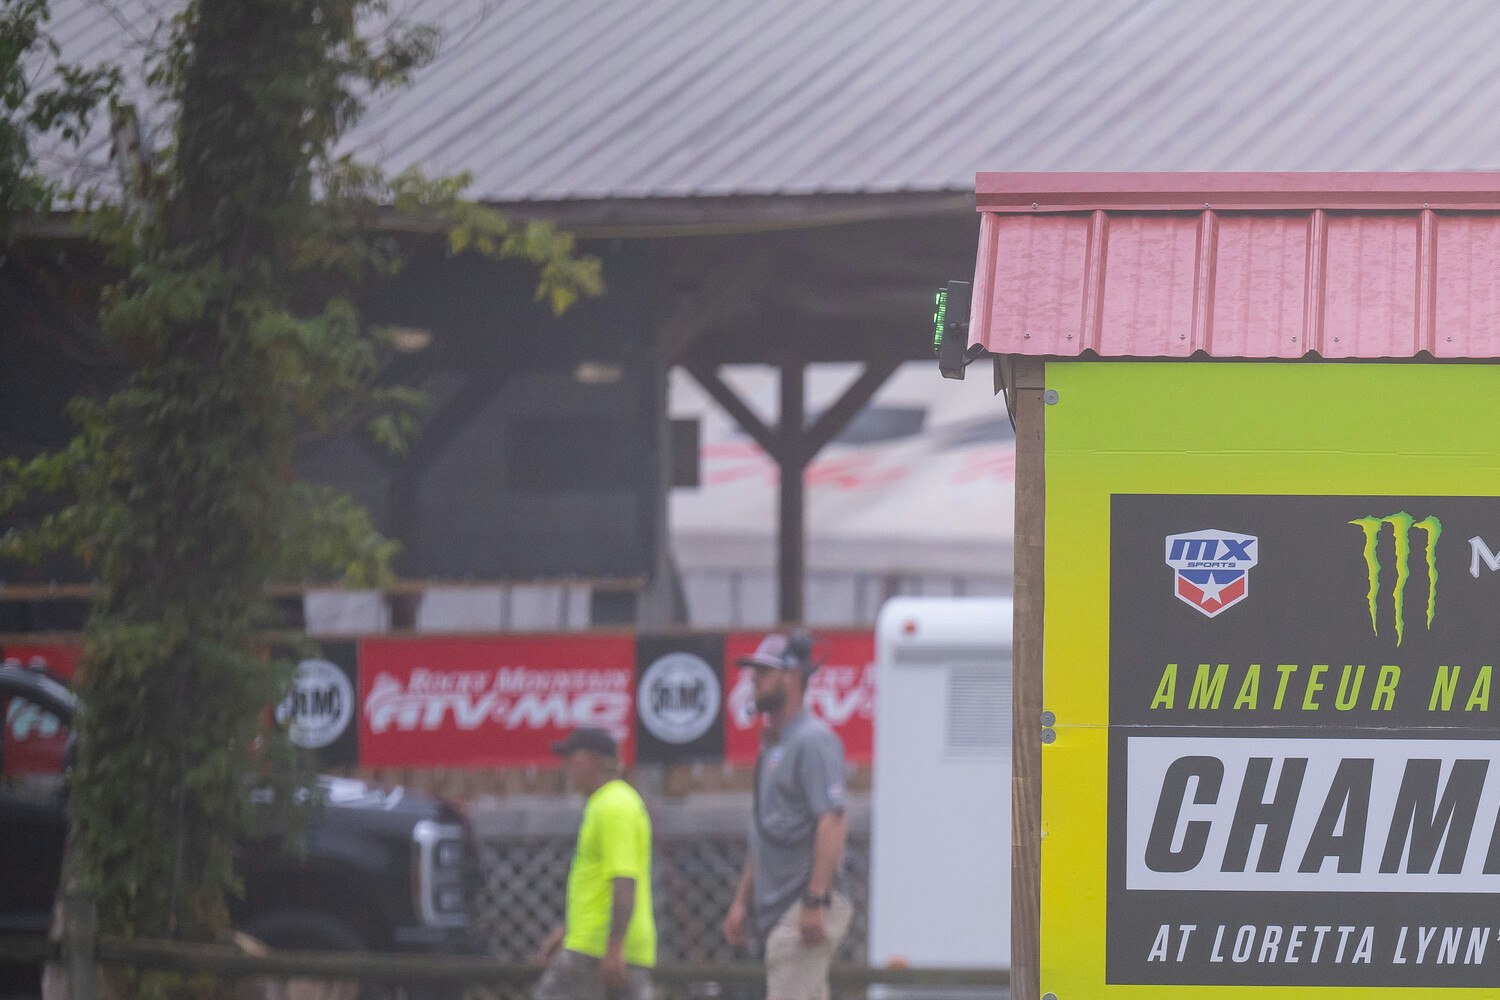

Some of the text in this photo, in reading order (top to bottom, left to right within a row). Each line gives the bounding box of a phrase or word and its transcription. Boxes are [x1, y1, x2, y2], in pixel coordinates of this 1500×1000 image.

[1168, 539, 1256, 560] MX
[1150, 663, 1402, 711] AMATEUR
[1147, 924, 1196, 962] AT
[1210, 925, 1375, 964] LORETTA
